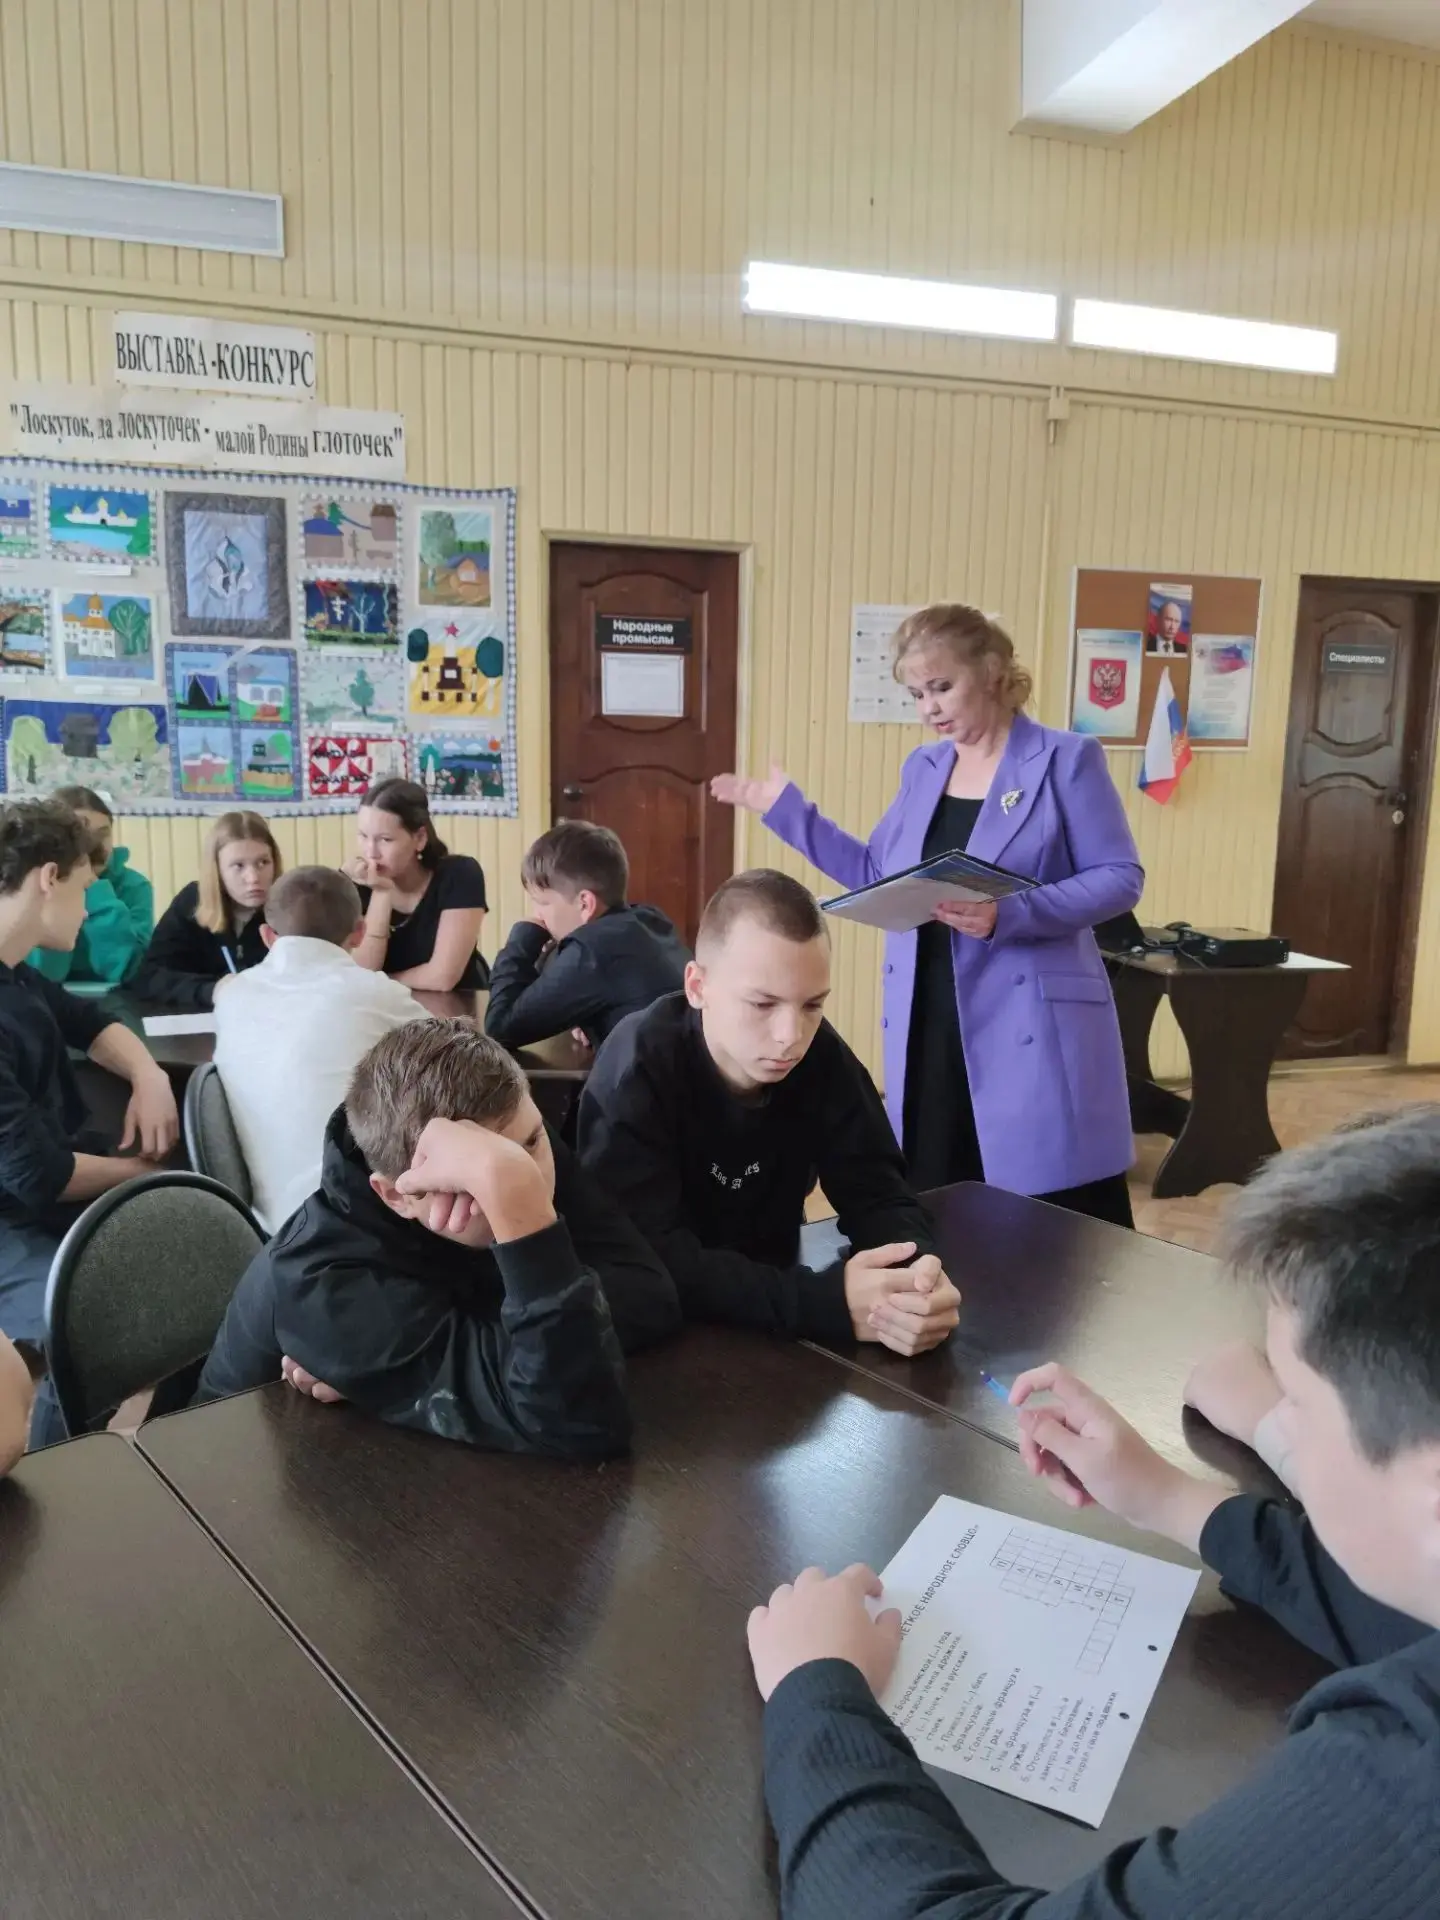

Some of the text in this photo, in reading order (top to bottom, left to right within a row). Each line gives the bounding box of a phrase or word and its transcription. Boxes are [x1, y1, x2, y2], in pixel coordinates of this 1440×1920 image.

[215, 424, 256, 455] малой
[258, 424, 309, 458] Родины
[313, 427, 402, 458] глоточек"
[613, 620, 674, 633] Народные
[612, 634, 675, 645] промыслы
[1329, 652, 1386, 664] Специалисты
[919, 1559, 957, 1604] НАРОДНОЕ
